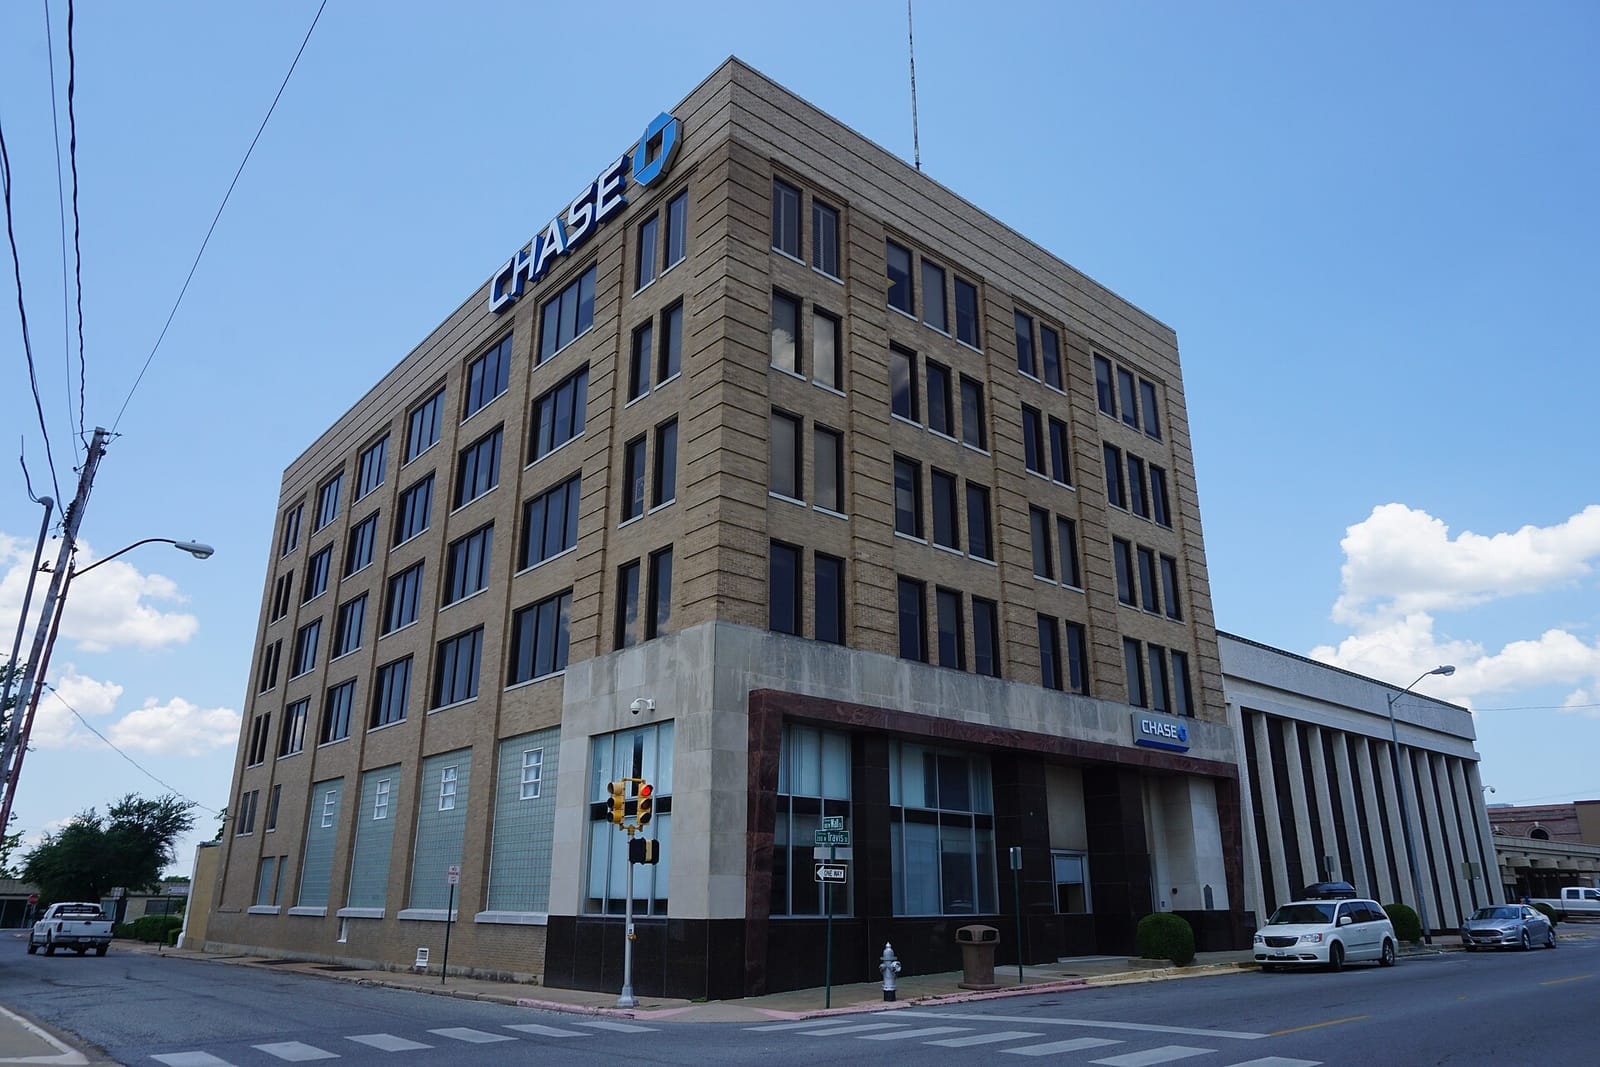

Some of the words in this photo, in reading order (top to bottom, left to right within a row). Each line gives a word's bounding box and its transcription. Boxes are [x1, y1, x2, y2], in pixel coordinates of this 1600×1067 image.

[489, 155, 628, 312] CHASE
[1141, 719, 1178, 738] CHASE
[828, 832, 844, 843] Travis
